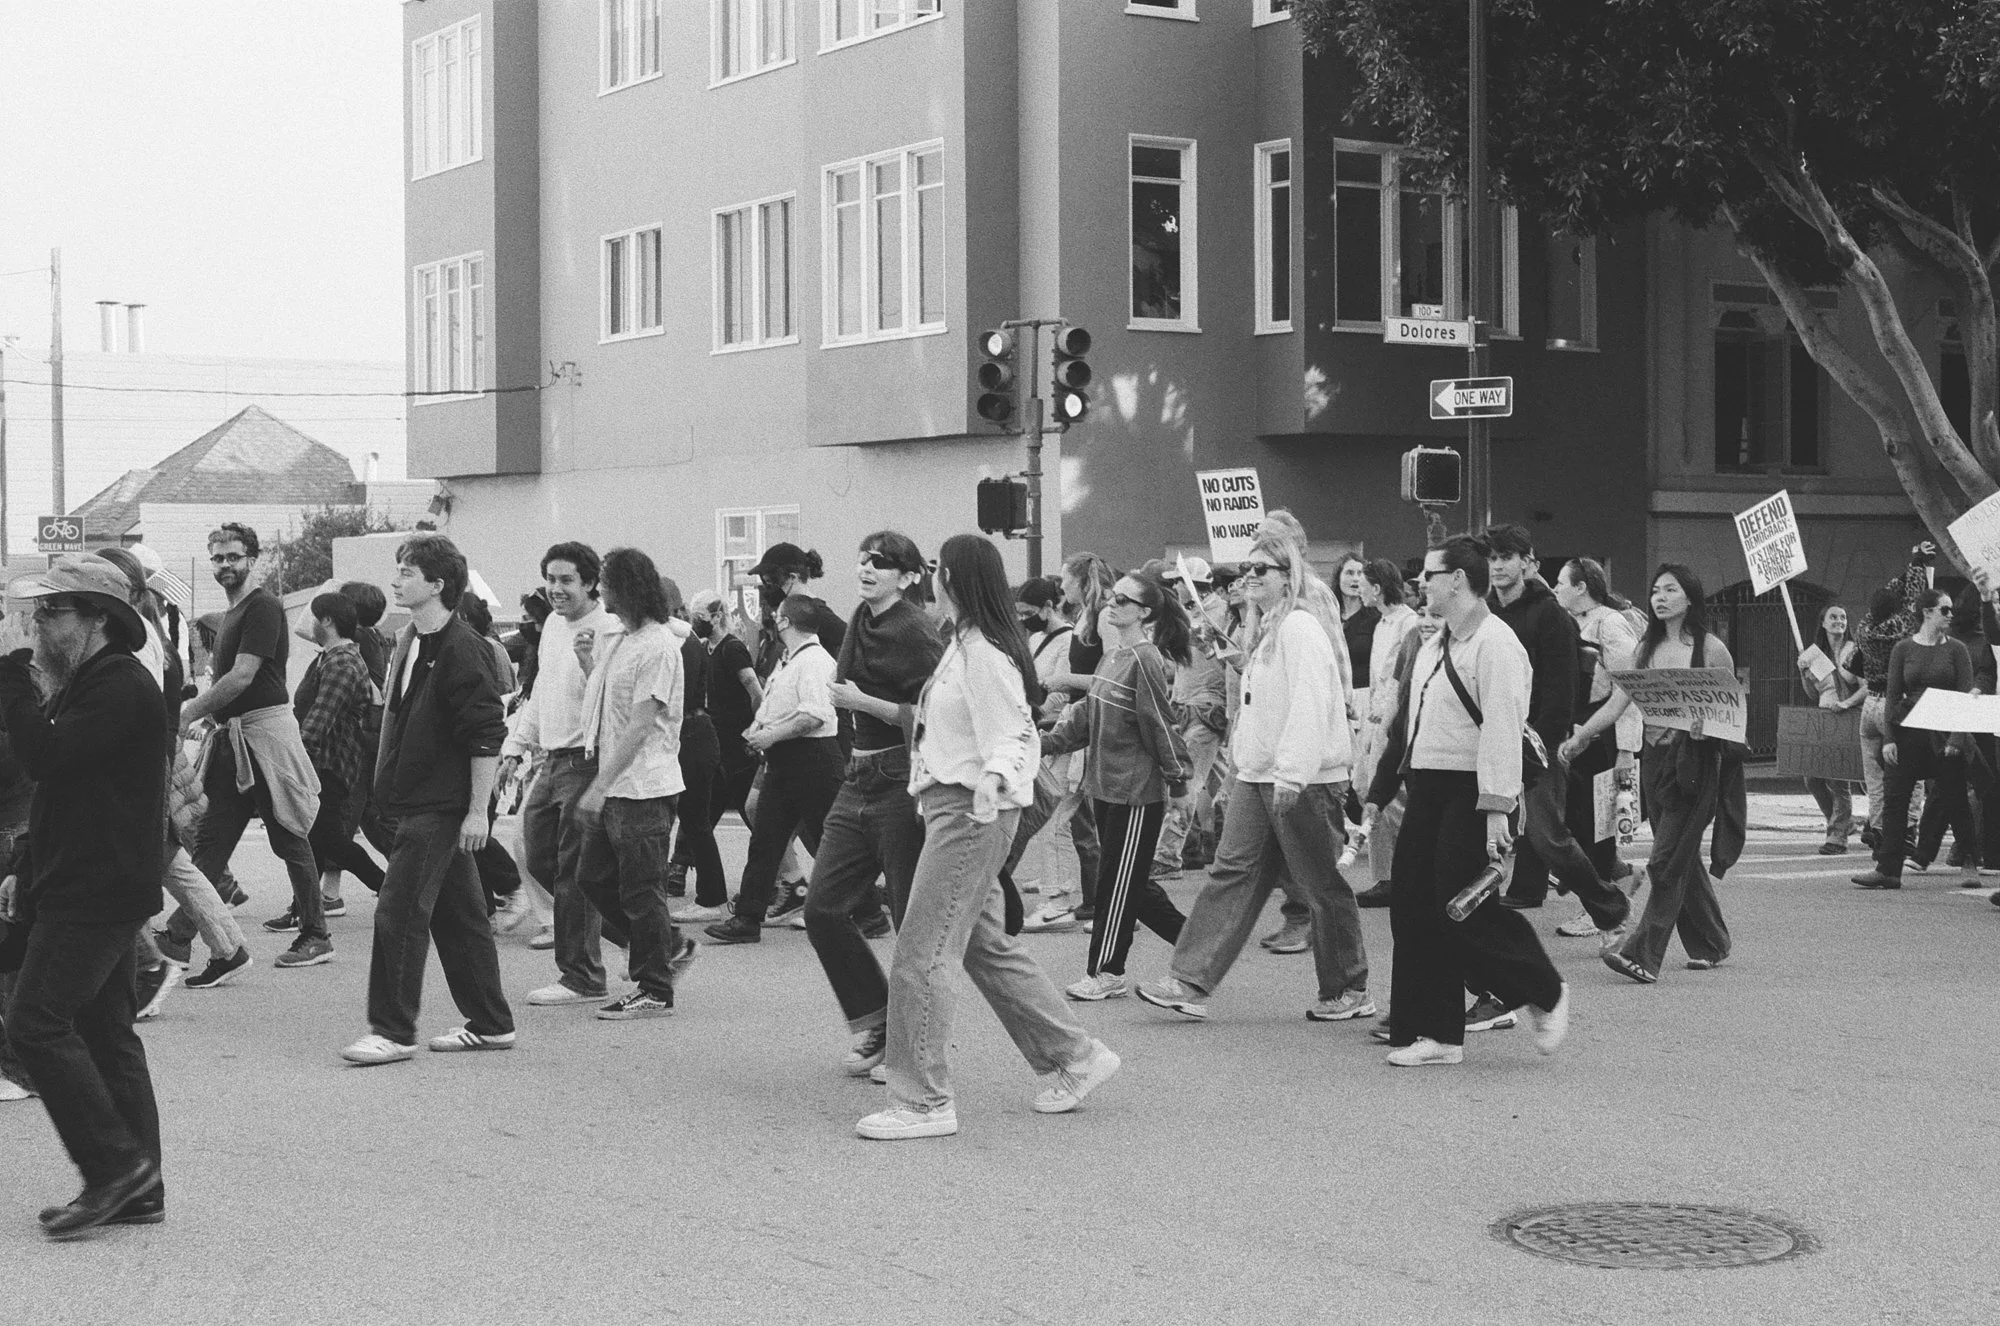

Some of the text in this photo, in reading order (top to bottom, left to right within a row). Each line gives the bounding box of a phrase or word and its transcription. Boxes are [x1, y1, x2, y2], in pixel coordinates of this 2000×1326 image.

[1418, 306, 1432, 316] 100
[1400, 323, 1456, 340] Dolores
[1454, 390, 1503, 406] ONE WAY
[1202, 475, 1256, 494] NO CUTS
[1205, 495, 1259, 512] NO RAIDS
[1739, 496, 1788, 539] DEFEND
[1211, 524, 1227, 539] NO
[64, 543, 82, 551] WAVE
[1780, 531, 1797, 551] FOR
[1757, 547, 1795, 576] A GENERAL
[1631, 690, 1740, 709] COMPASSION
[1643, 705, 1741, 728] BECOMES RADICAL
